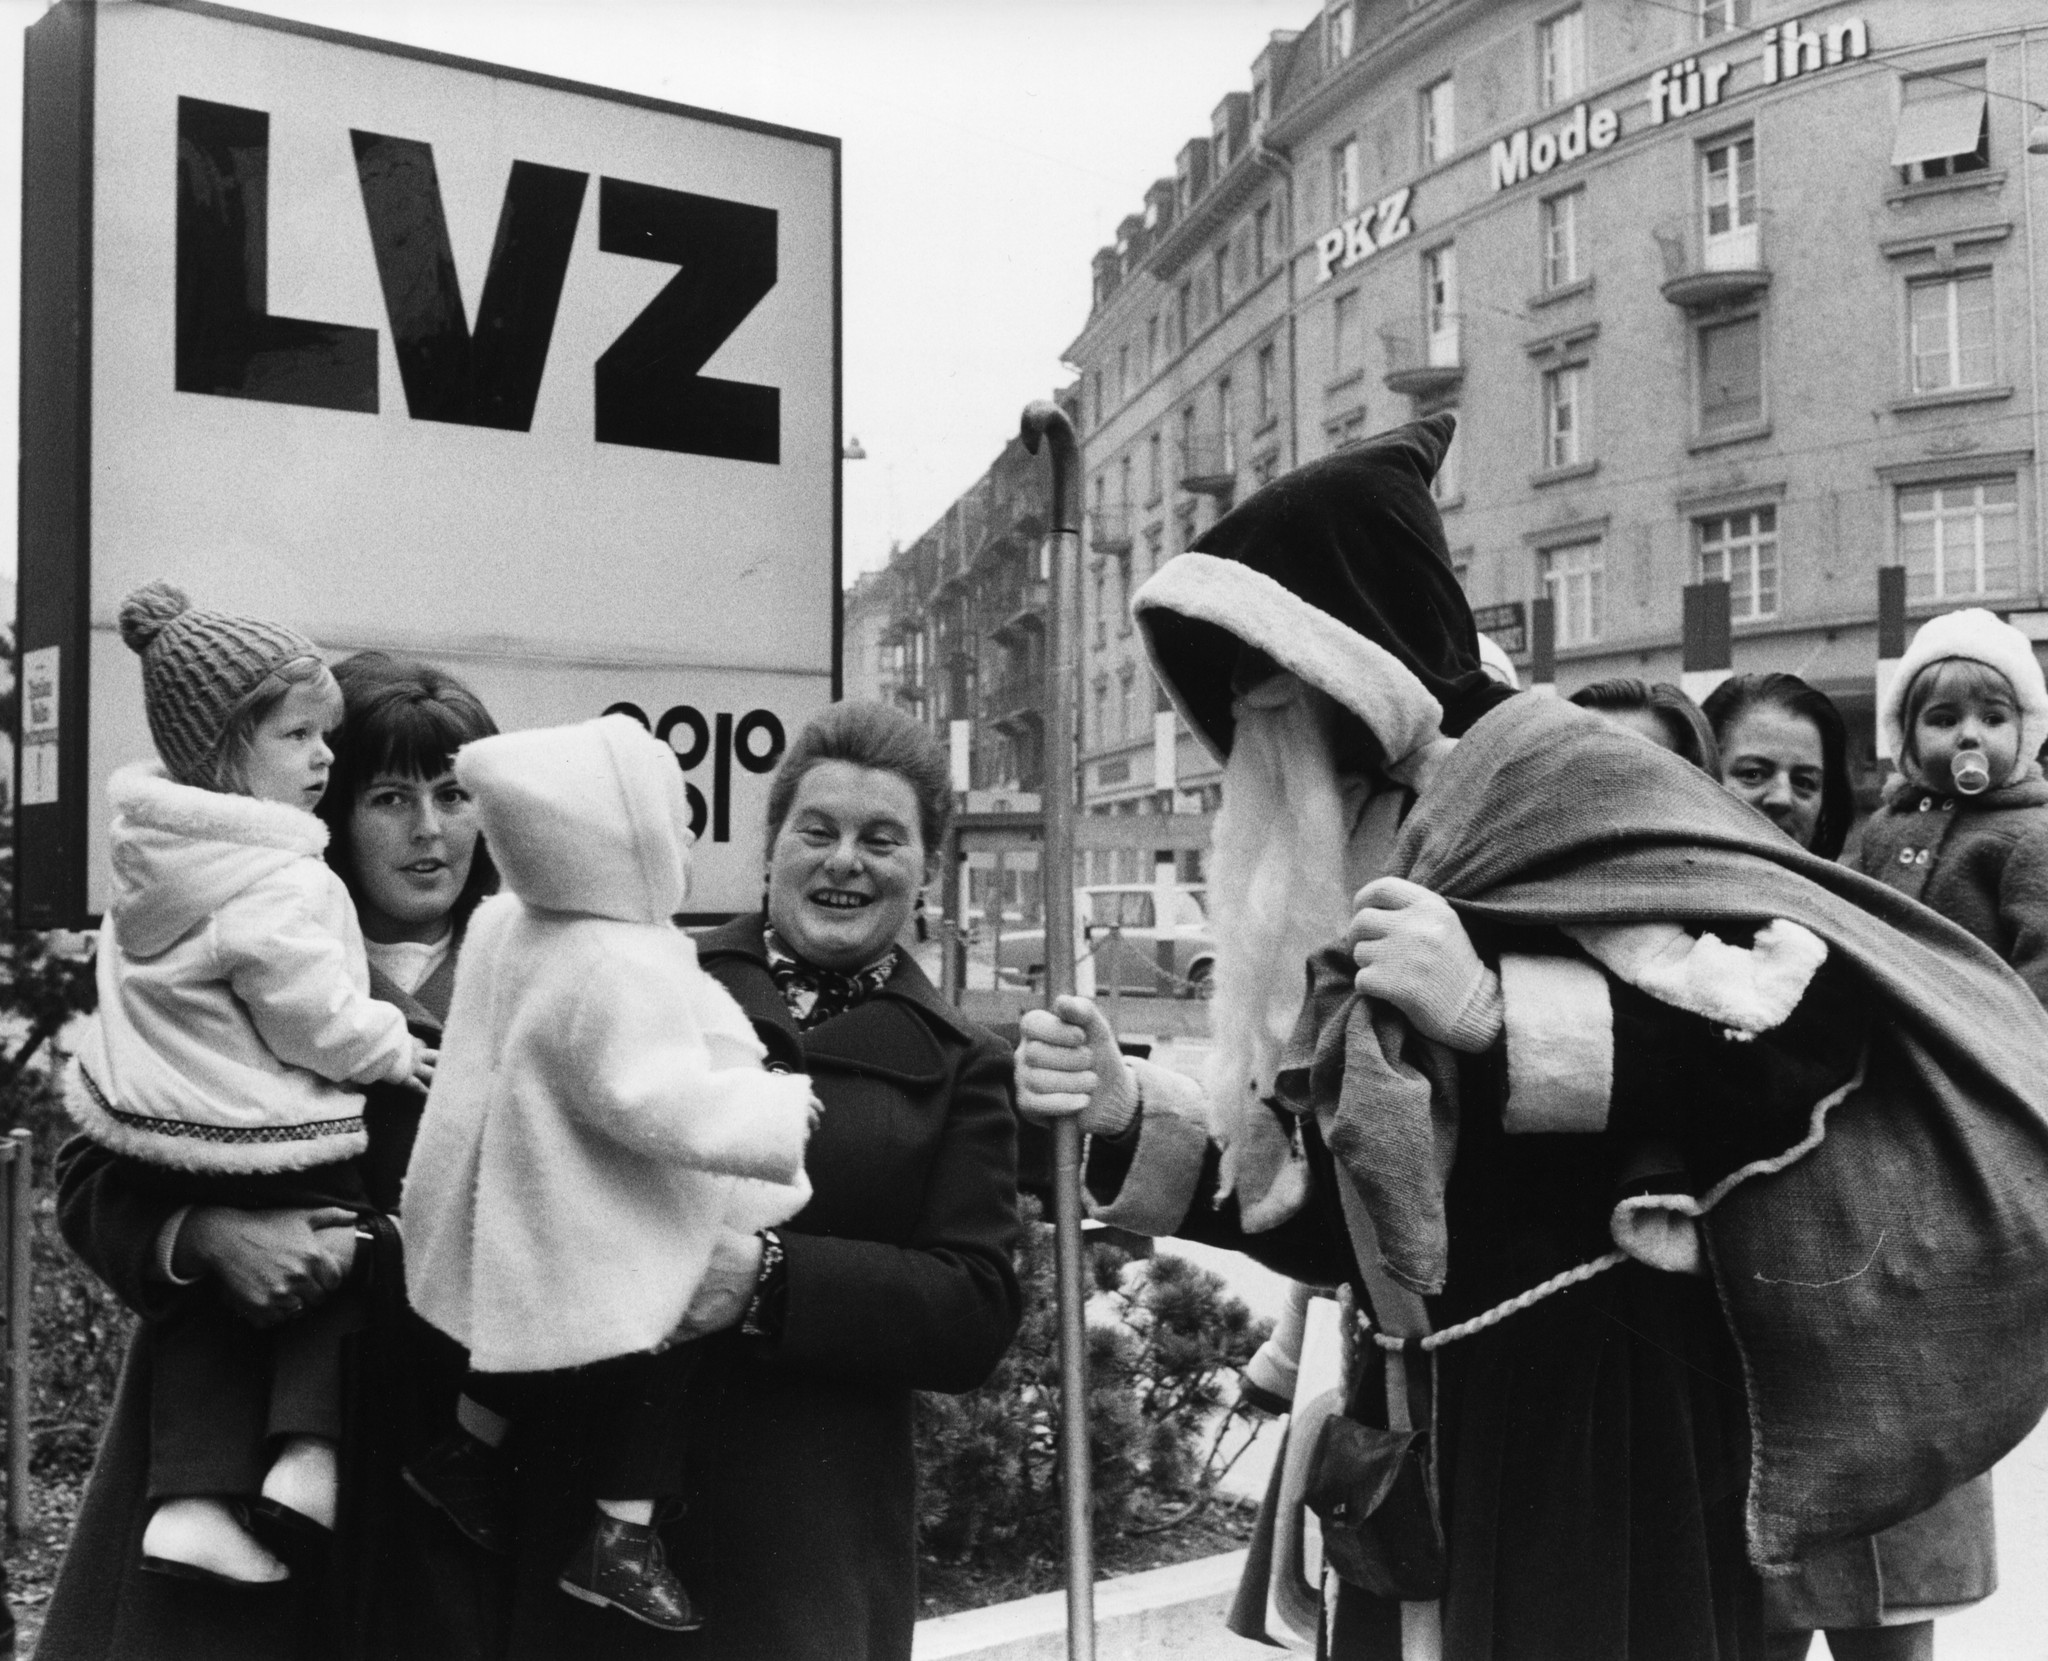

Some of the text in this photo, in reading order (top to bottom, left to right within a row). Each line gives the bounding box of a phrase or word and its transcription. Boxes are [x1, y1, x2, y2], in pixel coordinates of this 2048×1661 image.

[176, 96, 780, 464] LVZ
[1315, 18, 1868, 282] PKZ Mode für ihn
